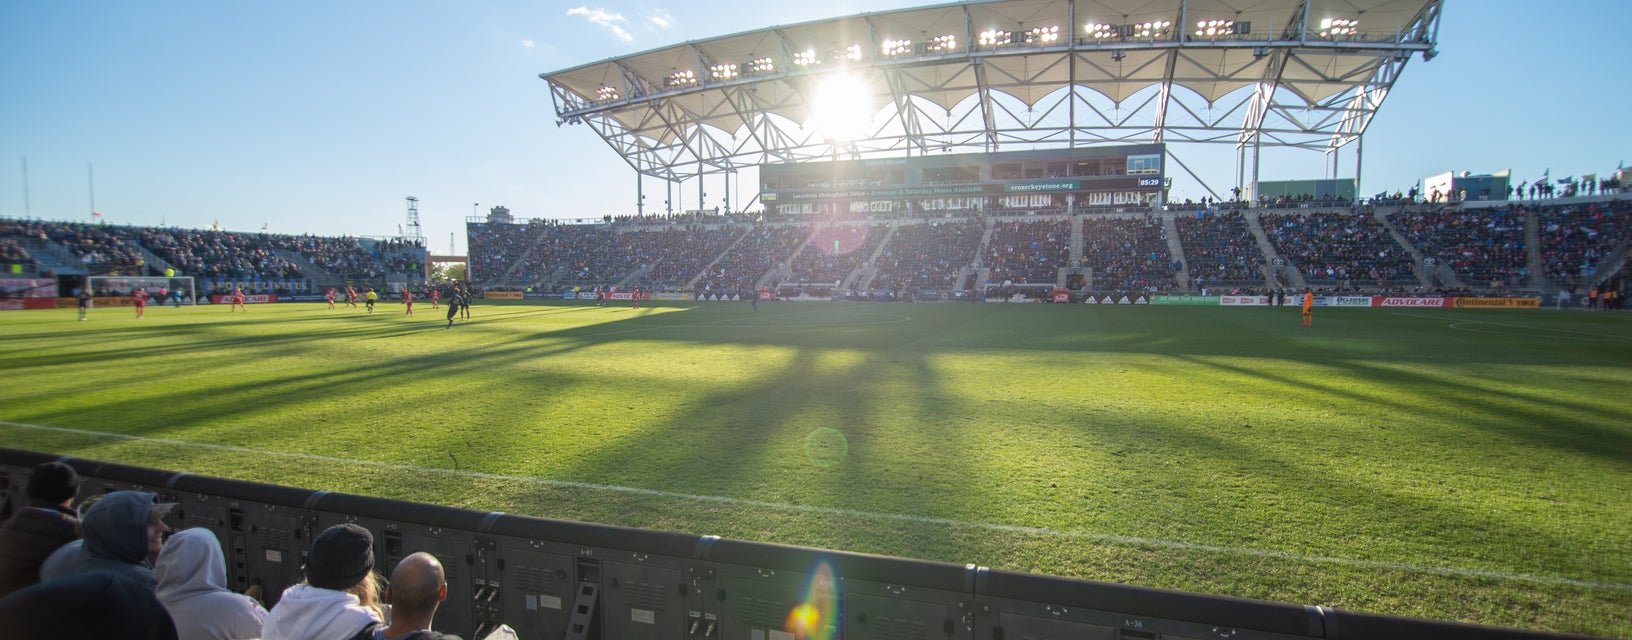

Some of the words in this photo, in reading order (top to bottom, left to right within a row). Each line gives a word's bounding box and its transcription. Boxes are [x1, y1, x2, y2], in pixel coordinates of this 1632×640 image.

[1010, 182, 1073, 190] crozerkeystone.org
[1382, 297, 1442, 306] ADVOCARE
[1456, 298, 1505, 308] Continental
